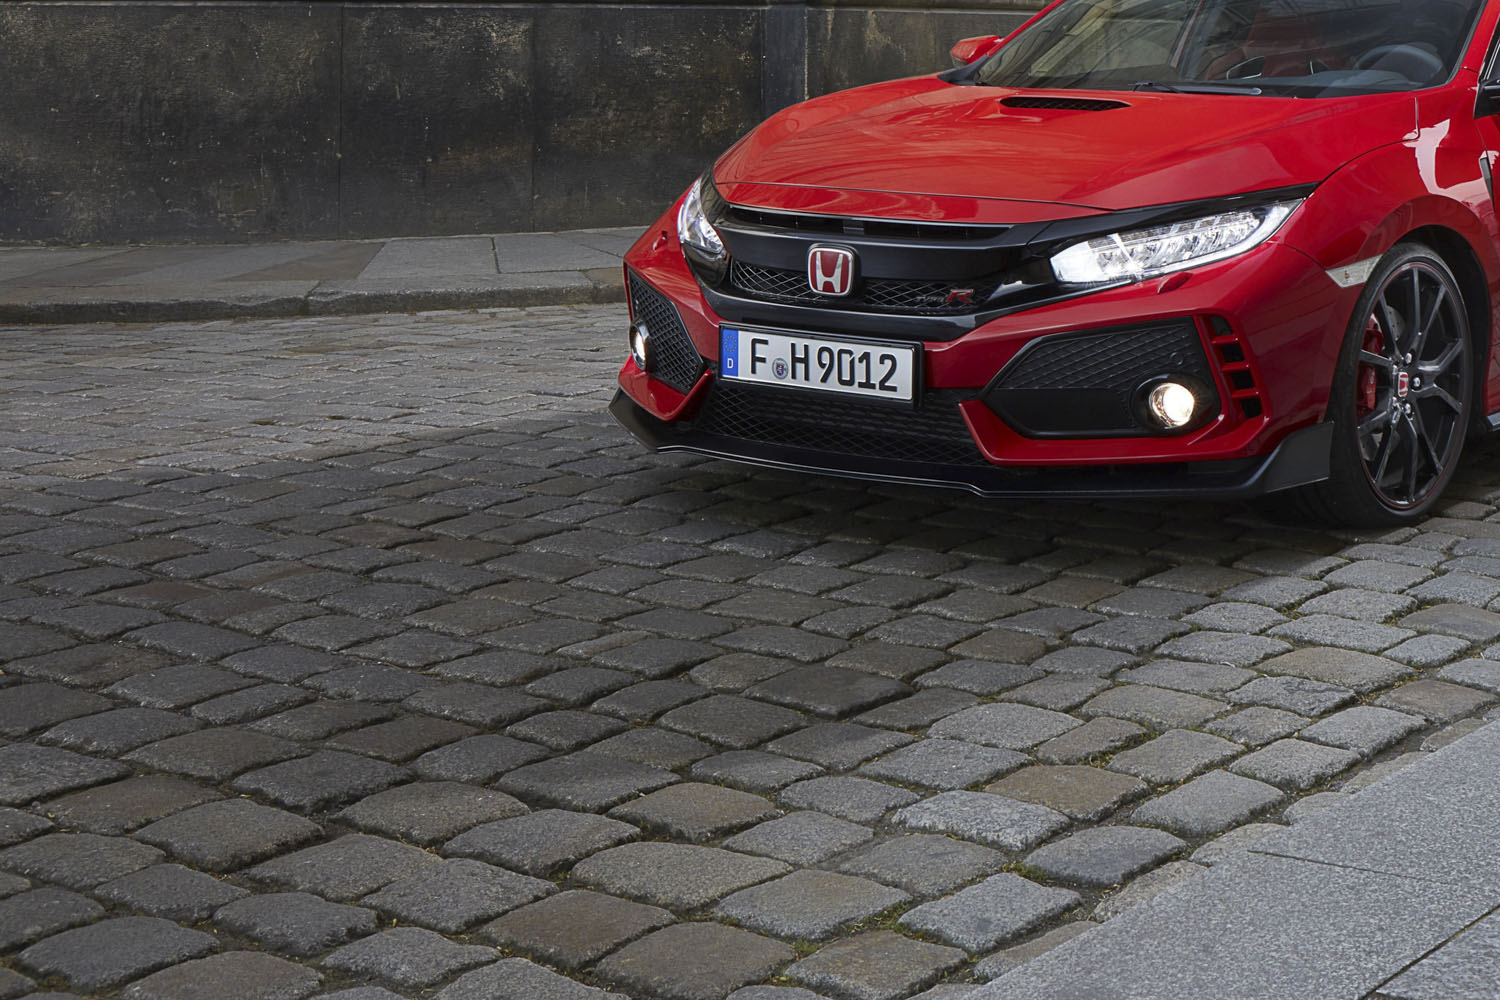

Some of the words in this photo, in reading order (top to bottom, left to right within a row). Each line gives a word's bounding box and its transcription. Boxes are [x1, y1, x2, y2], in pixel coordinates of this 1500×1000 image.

[945, 289, 975, 303] R
[750, 337, 769, 374] F
[727, 357, 734, 369] D
